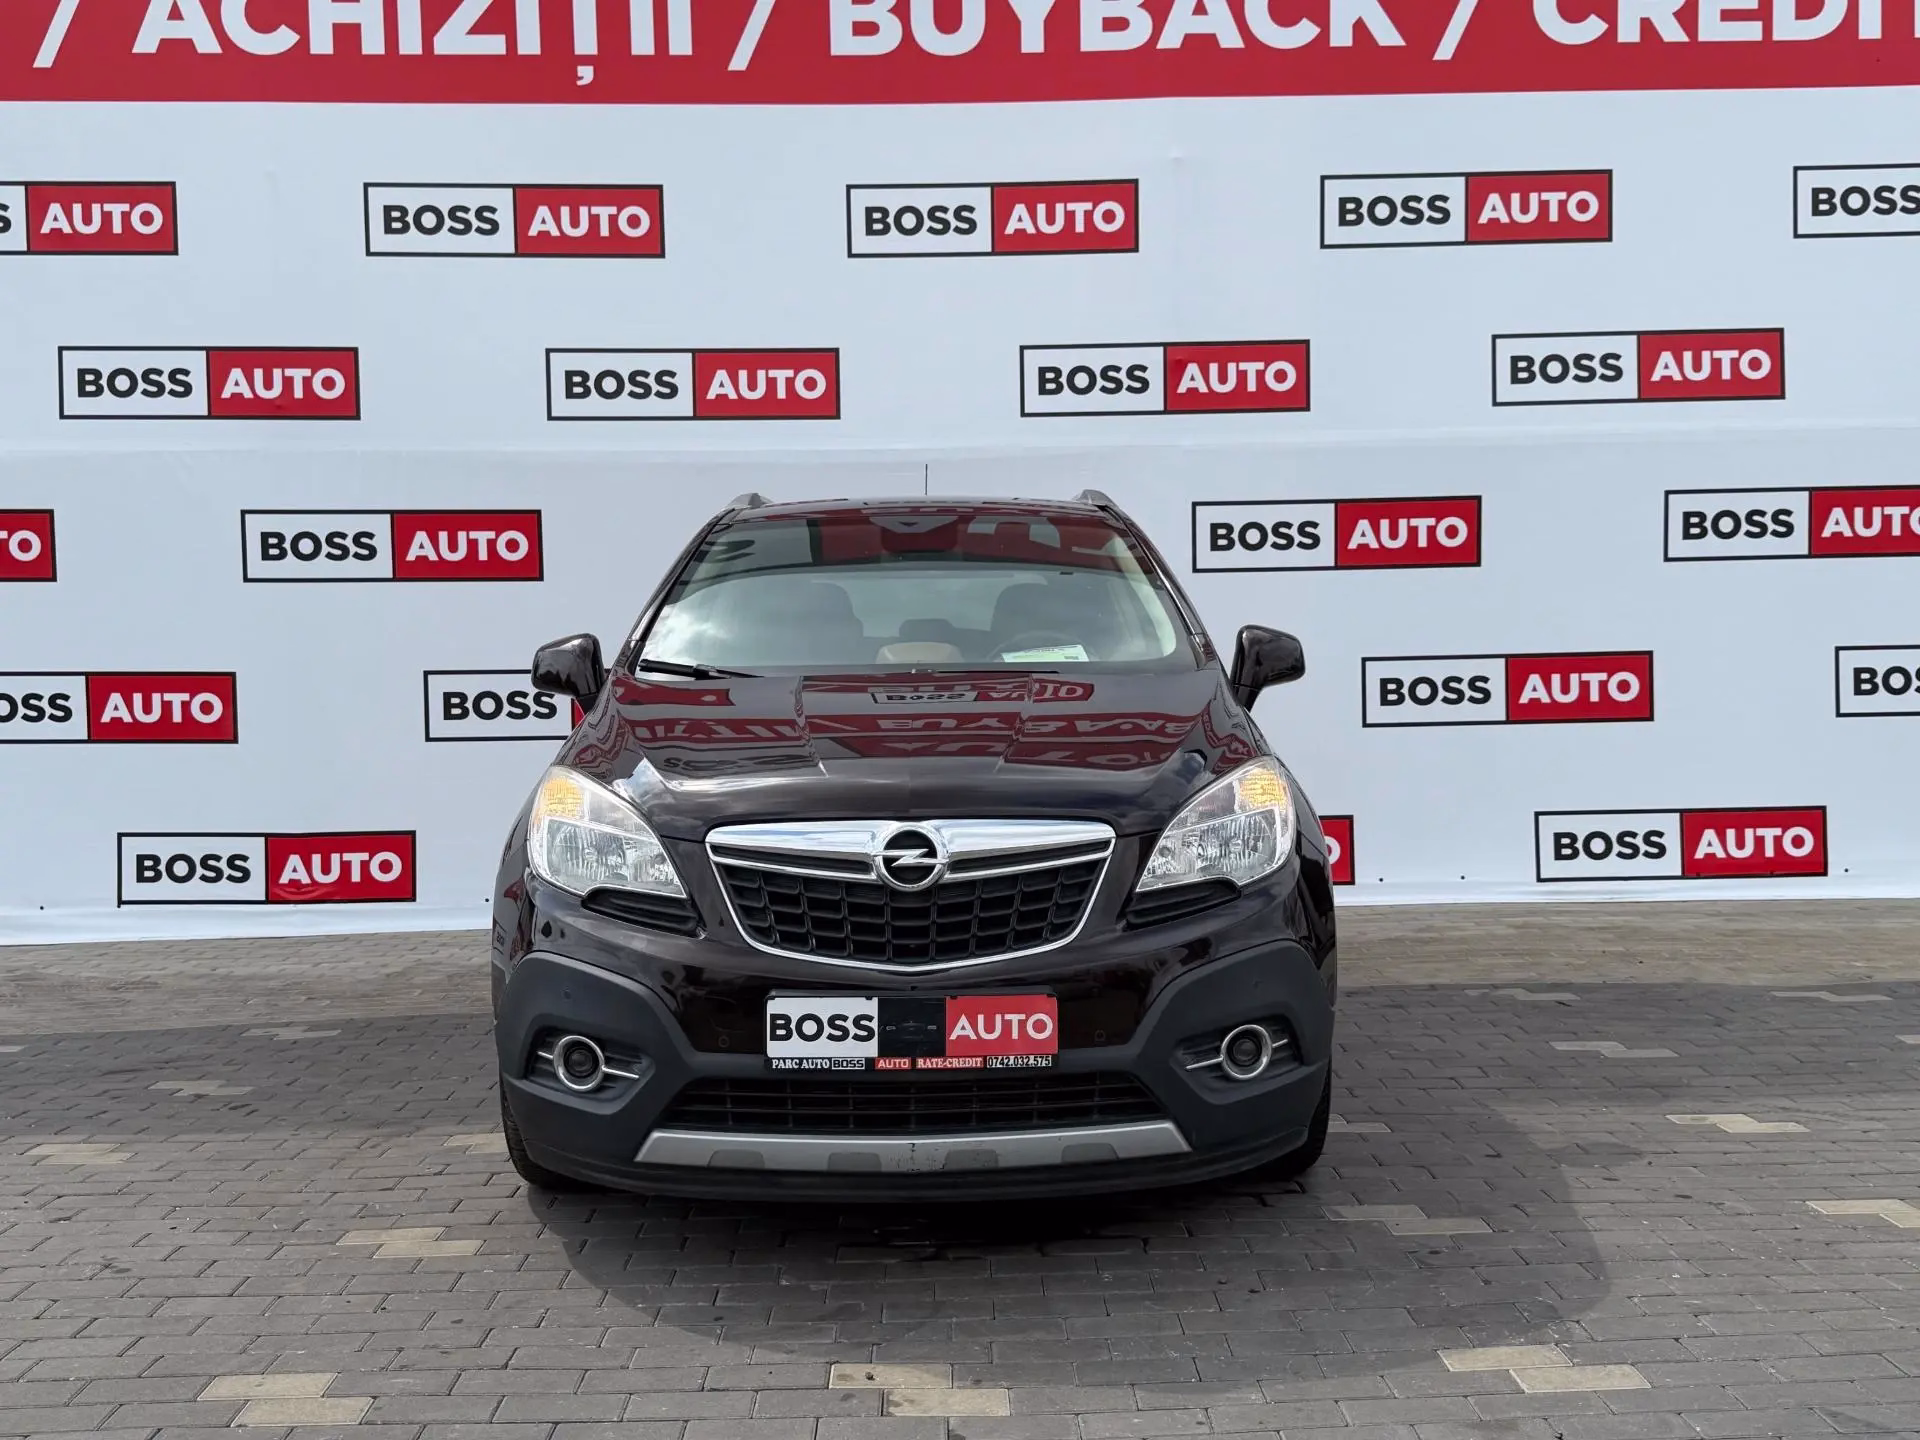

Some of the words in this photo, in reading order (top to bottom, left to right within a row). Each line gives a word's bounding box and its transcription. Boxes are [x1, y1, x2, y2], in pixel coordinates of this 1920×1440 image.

[830, 0, 1406, 56] BUYBACK
[1339, 195, 1450, 226] BOSS
[1478, 191, 1598, 223] AUTO
[1812, 185, 1920, 216] BOSS
[40, 203, 163, 234] AUTO
[384, 205, 499, 235] BOSS
[528, 206, 650, 237] AUTO
[865, 205, 976, 235] BOSS
[1005, 201, 1125, 234] AUTO
[1039, 365, 1149, 395] BOSS
[1177, 361, 1296, 393] AUTO
[1511, 353, 1622, 384] BOSS
[1651, 349, 1771, 381] AUTO
[78, 368, 192, 398] BOSS
[221, 368, 345, 399] AUTO
[565, 370, 678, 399] BOSS
[707, 369, 826, 399] AUTO
[1210, 521, 1320, 551] BOSS
[1348, 517, 1467, 549] AUTO
[1683, 509, 1794, 540] BOSS
[261, 531, 377, 561] BOSS
[406, 531, 528, 561] AUTO
[1380, 676, 1491, 706] BOSS
[1520, 672, 1639, 703] AUTO
[0, 693, 72, 722] OSS
[101, 693, 222, 723] AUTO
[443, 690, 558, 720] BOSS
[1554, 830, 1666, 860] BOSS
[1695, 827, 1813, 858] AUTO
[136, 854, 250, 883] BOSS
[280, 852, 402, 884] AUTO
[769, 1013, 876, 1042] BOSS
[949, 1013, 1053, 1040] AUTO
[771, 1058, 800, 1069] PARC
[801, 1058, 830, 1069] AUTO
[832, 1058, 864, 1069] BOSS
[877, 1058, 910, 1068] AUTO
[916, 1057, 983, 1068] RATE-CREDIT
[987, 1056, 1051, 1068] 0742.032.575
